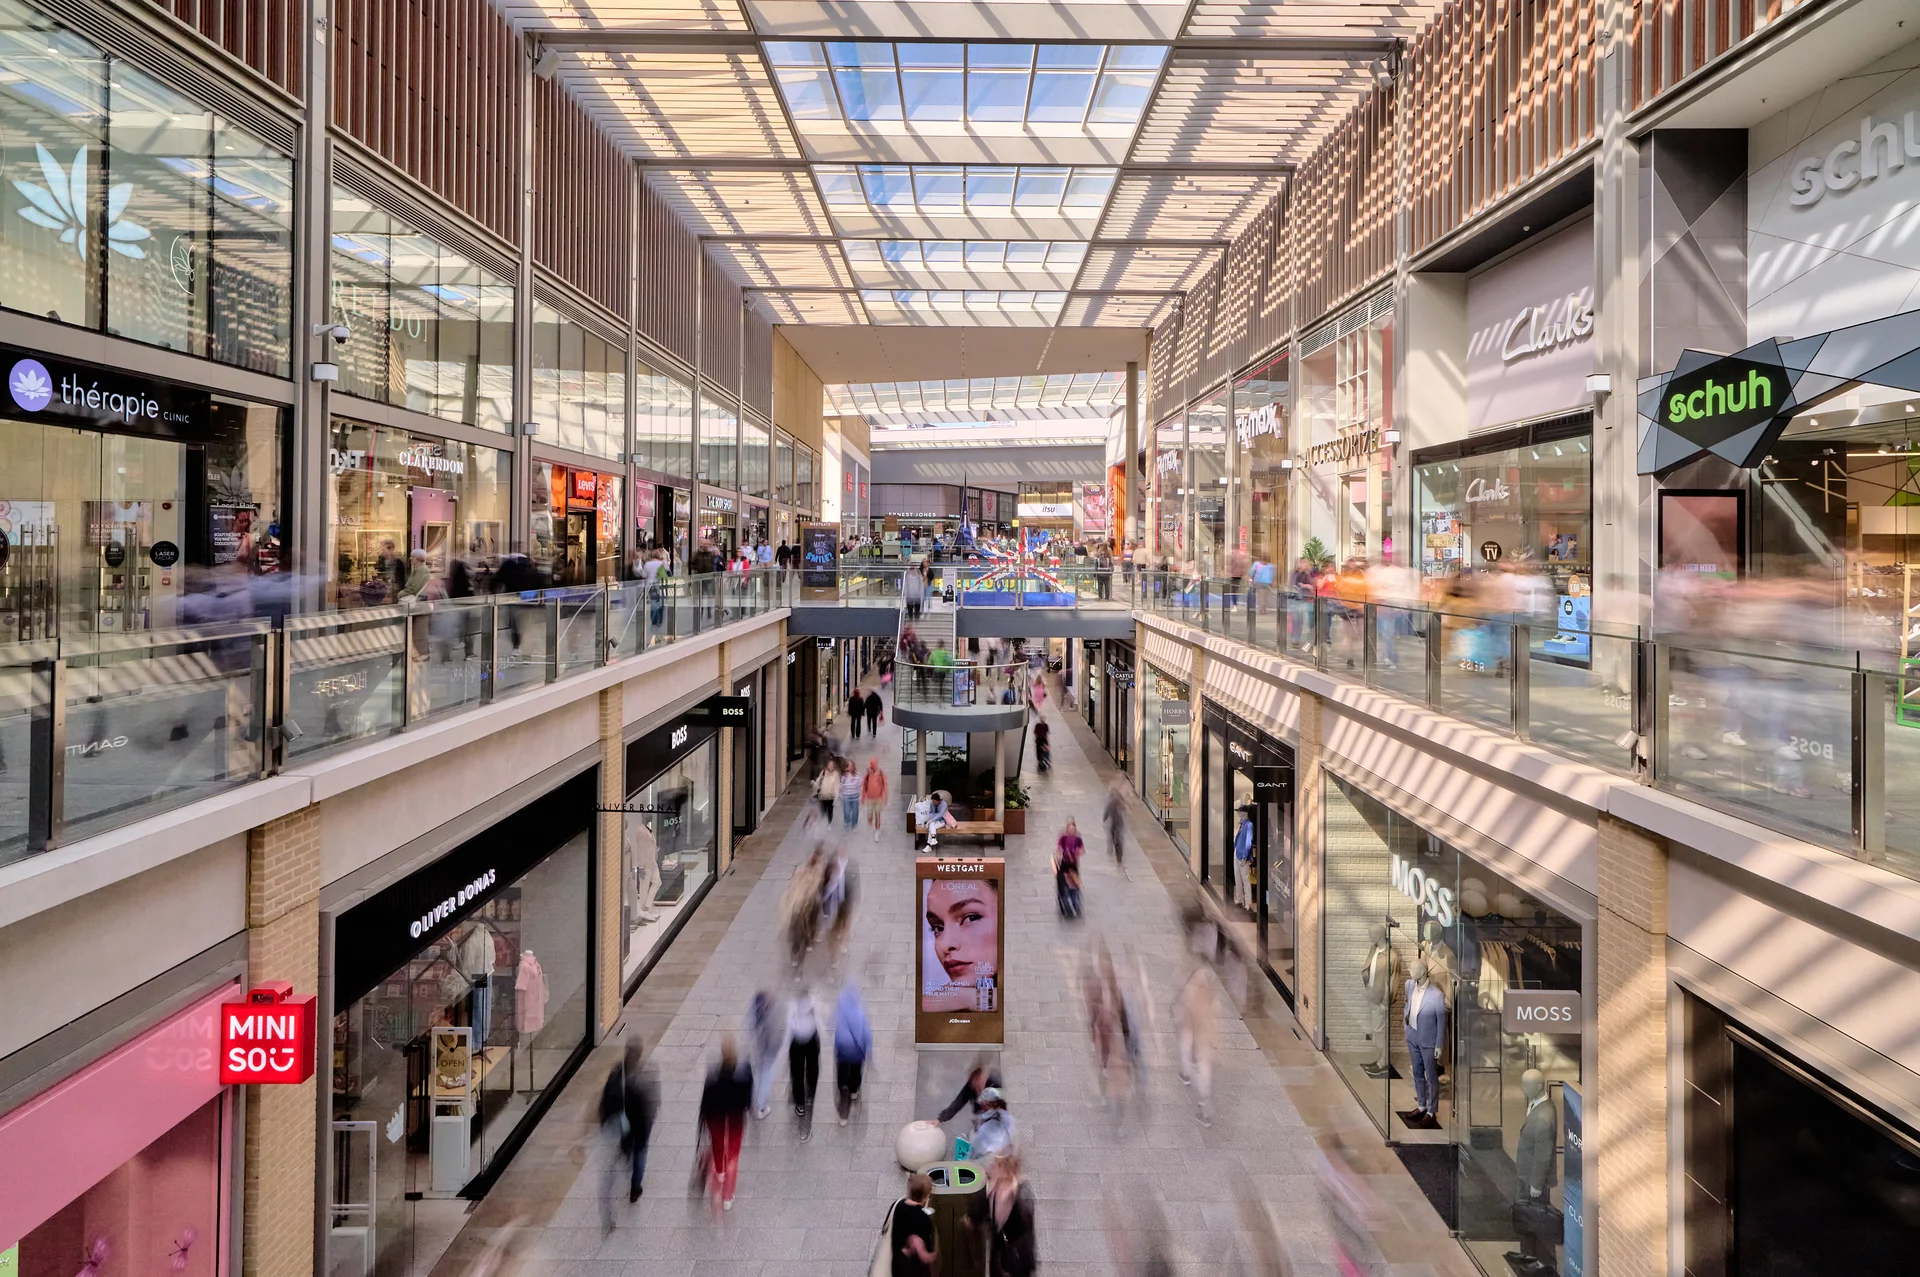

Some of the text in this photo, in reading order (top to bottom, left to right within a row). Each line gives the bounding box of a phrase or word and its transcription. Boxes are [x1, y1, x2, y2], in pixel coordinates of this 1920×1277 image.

[1502, 294, 1593, 360] Clarks
[61, 373, 190, 424] thérapie CLINIC
[1668, 369, 1771, 423] schuh
[1304, 428, 1380, 468] ACCESSORIZE
[399, 451, 464, 476] CLARENDON
[1465, 478, 1510, 502] Clarks
[805, 552, 834, 563] SMILE?
[813, 541, 827, 549] MADE
[1485, 548, 1498, 560] TV
[671, 725, 688, 750] BOSS
[1229, 741, 1252, 762] GANT
[664, 816, 683, 827] BOSS
[937, 864, 984, 872] WESTGATE
[410, 868, 496, 938] OLIVER BONAS
[1392, 853, 1453, 928] MOSS
[1517, 1006, 1572, 1021] MOSS
[229, 1015, 295, 1040] MINI
